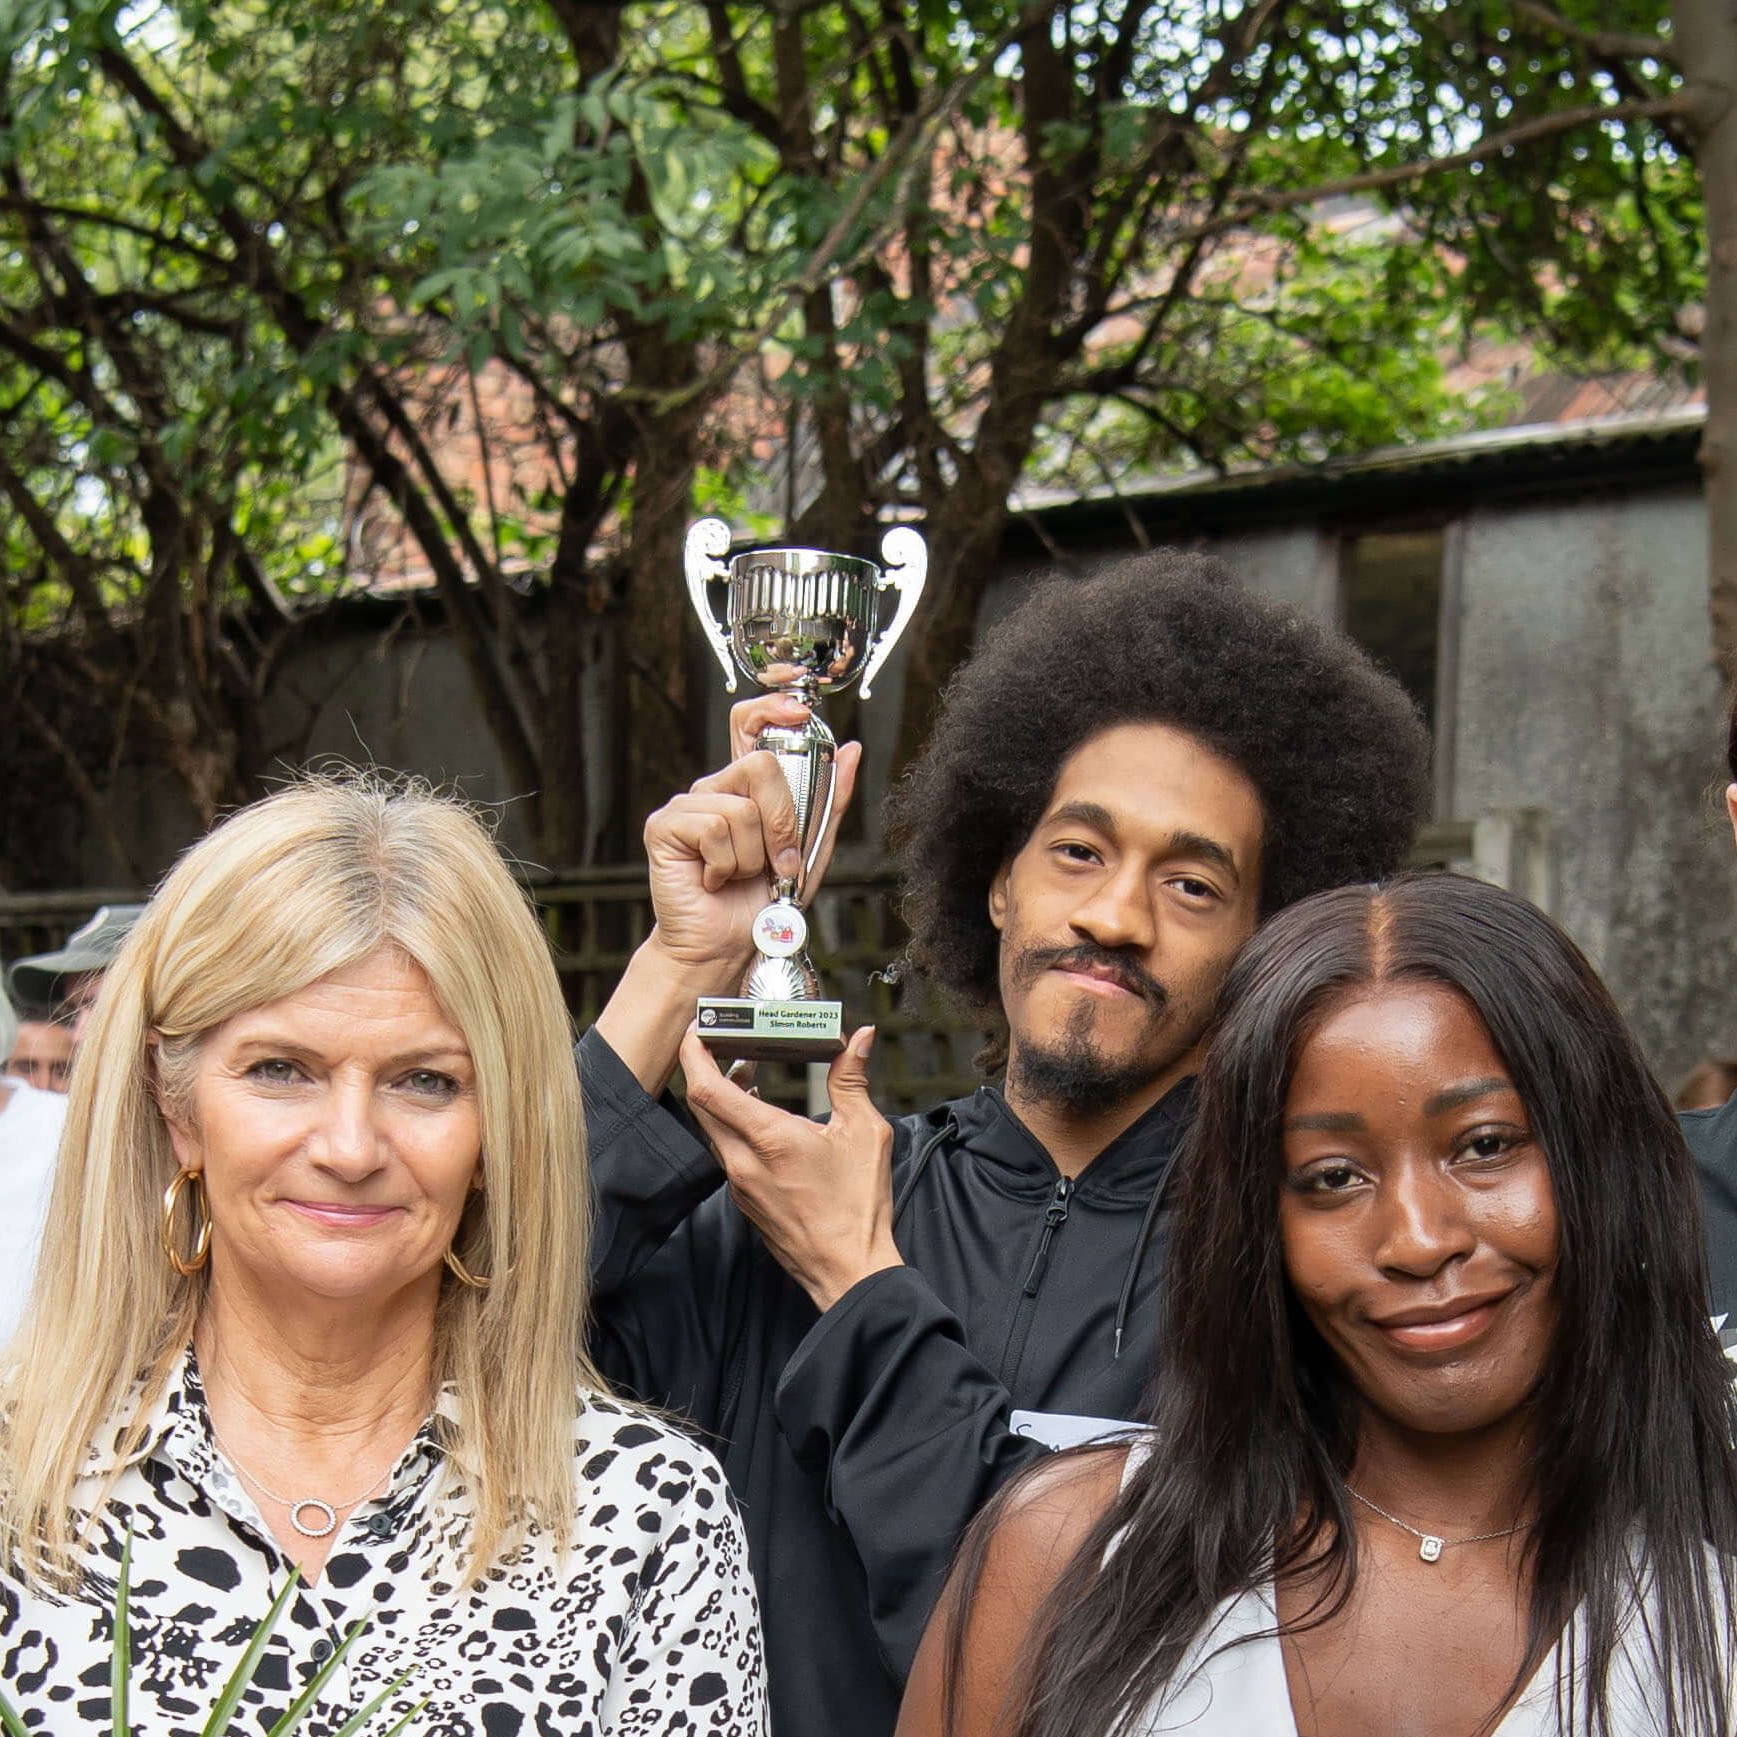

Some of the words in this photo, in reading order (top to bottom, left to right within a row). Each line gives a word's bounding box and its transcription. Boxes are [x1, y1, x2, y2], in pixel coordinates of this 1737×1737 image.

[759, 1010, 778, 1018] Head
[780, 1010, 816, 1019] Gardener
[818, 1011, 839, 1020] 2023
[796, 1020, 827, 1029] Roberts
